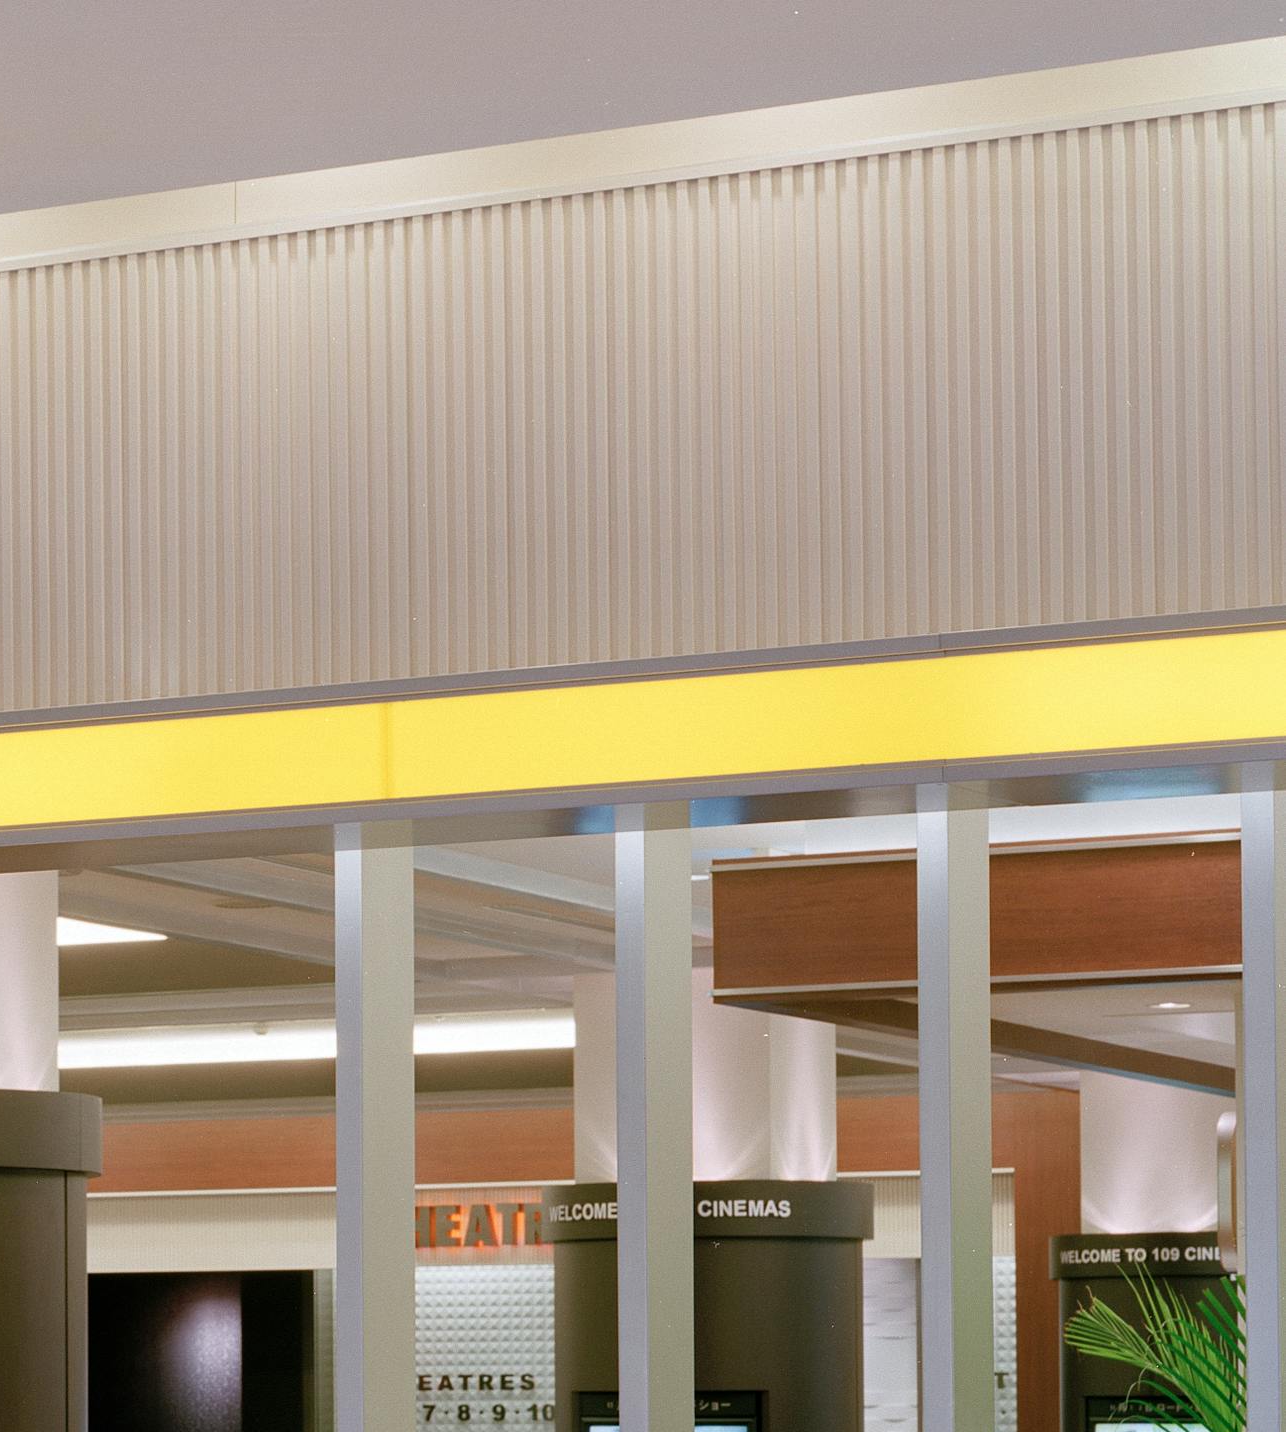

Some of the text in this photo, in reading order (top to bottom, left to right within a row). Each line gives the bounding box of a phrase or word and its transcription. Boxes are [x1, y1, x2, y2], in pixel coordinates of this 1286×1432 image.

[549, 1199, 792, 1222] WELCOME CINEMAS
[1060, 1248, 1121, 1264] WELCOME
[1125, 1247, 1147, 1262] TO
[1152, 1247, 1180, 1262] 109
[418, 1374, 535, 1391] EATRES
